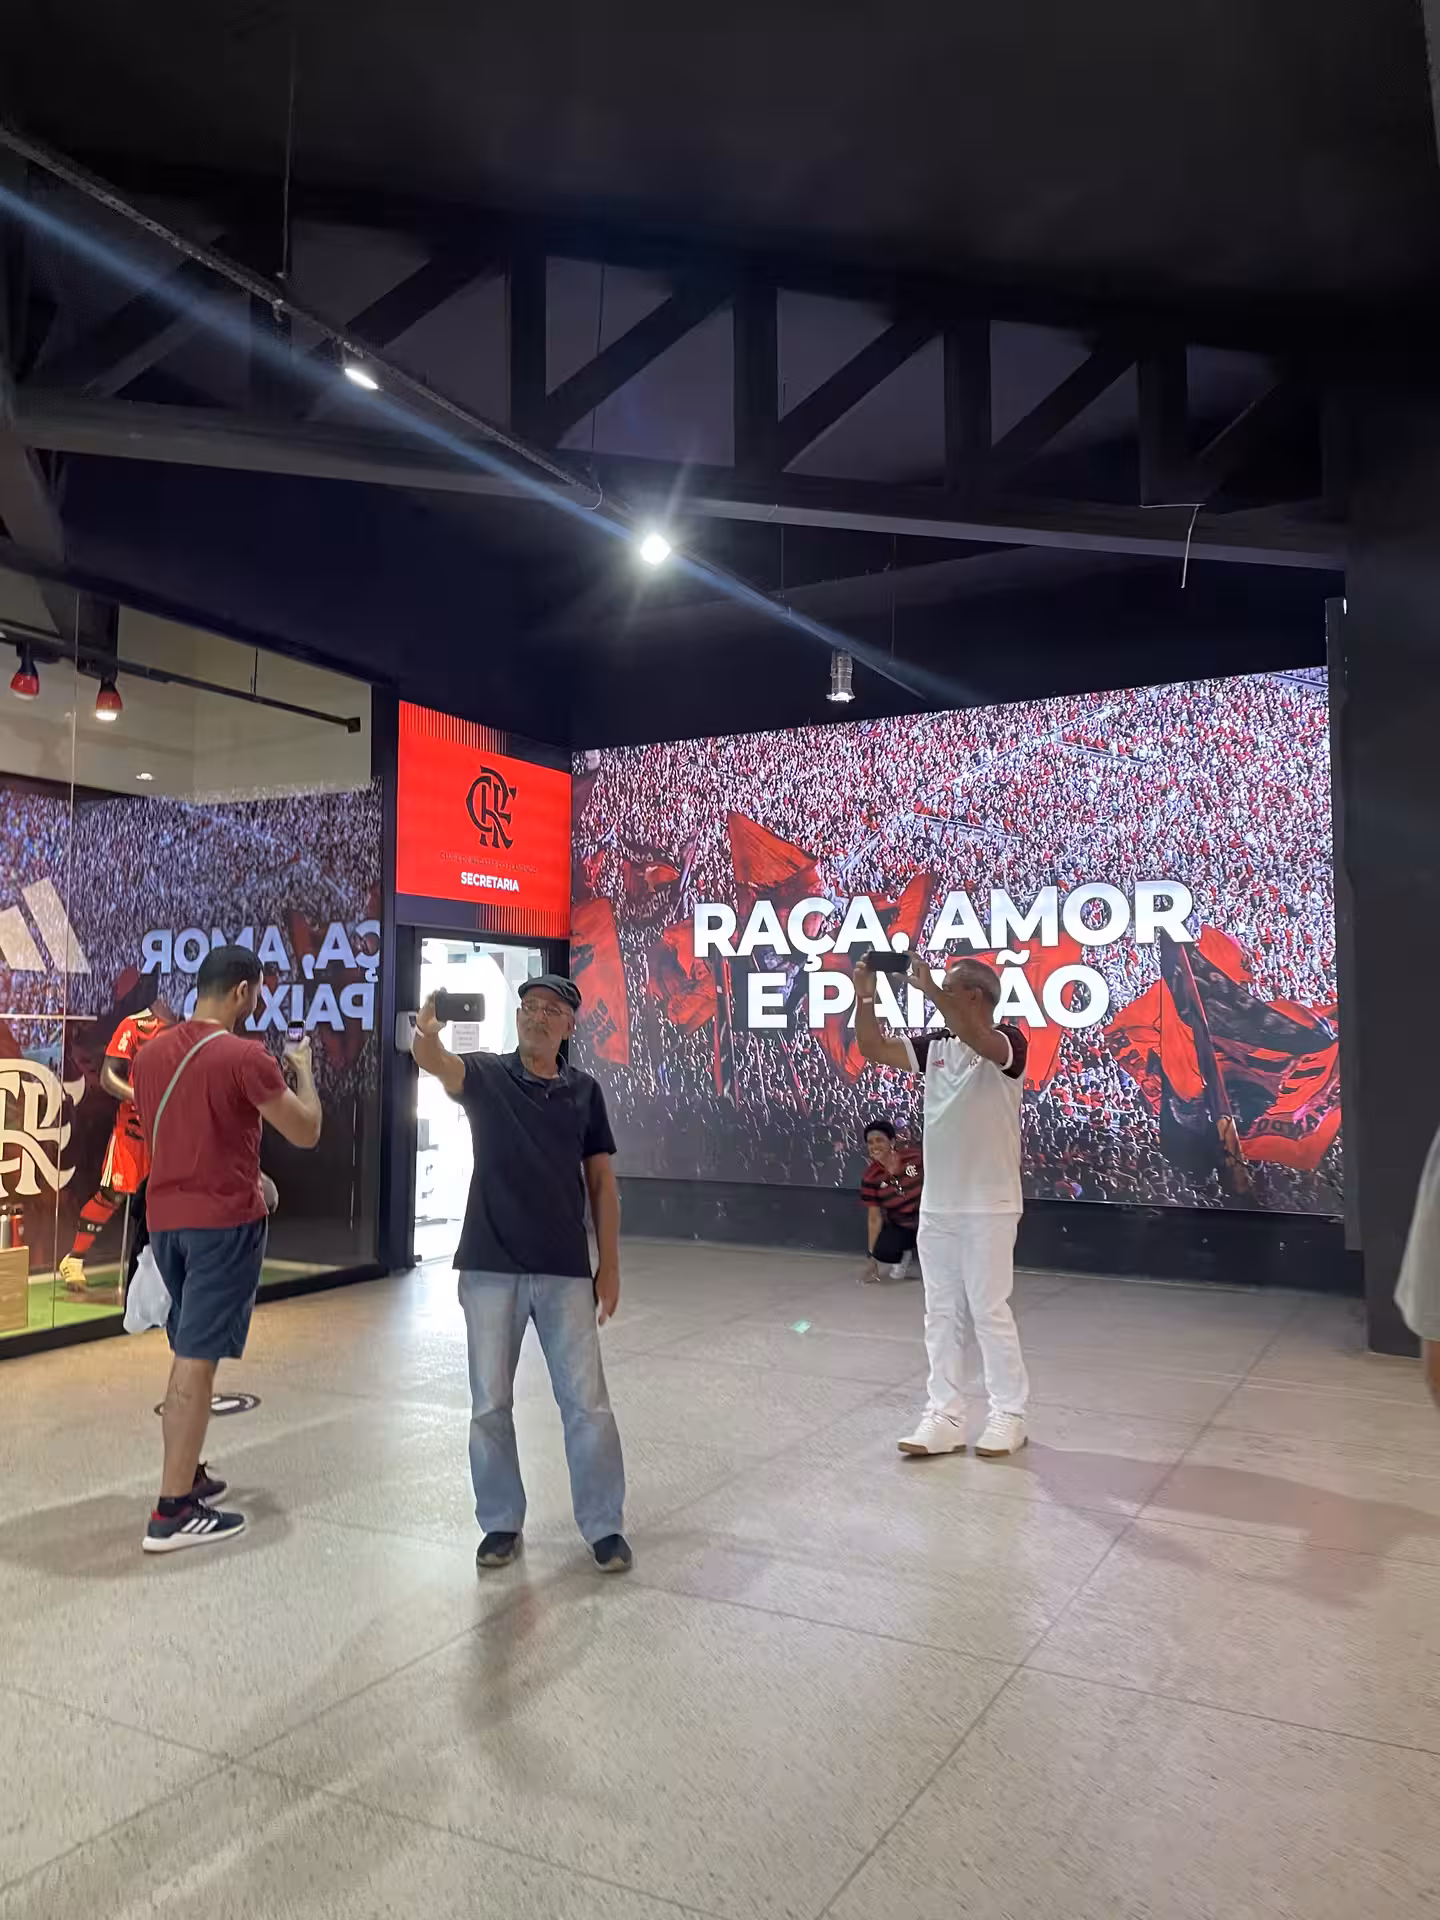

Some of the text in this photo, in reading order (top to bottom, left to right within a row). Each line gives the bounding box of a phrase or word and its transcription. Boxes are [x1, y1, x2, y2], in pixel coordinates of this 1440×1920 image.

[461, 872, 519, 893] SECRETARIA
[927, 880, 1195, 951] AMOR
[747, 971, 788, 1029] E
